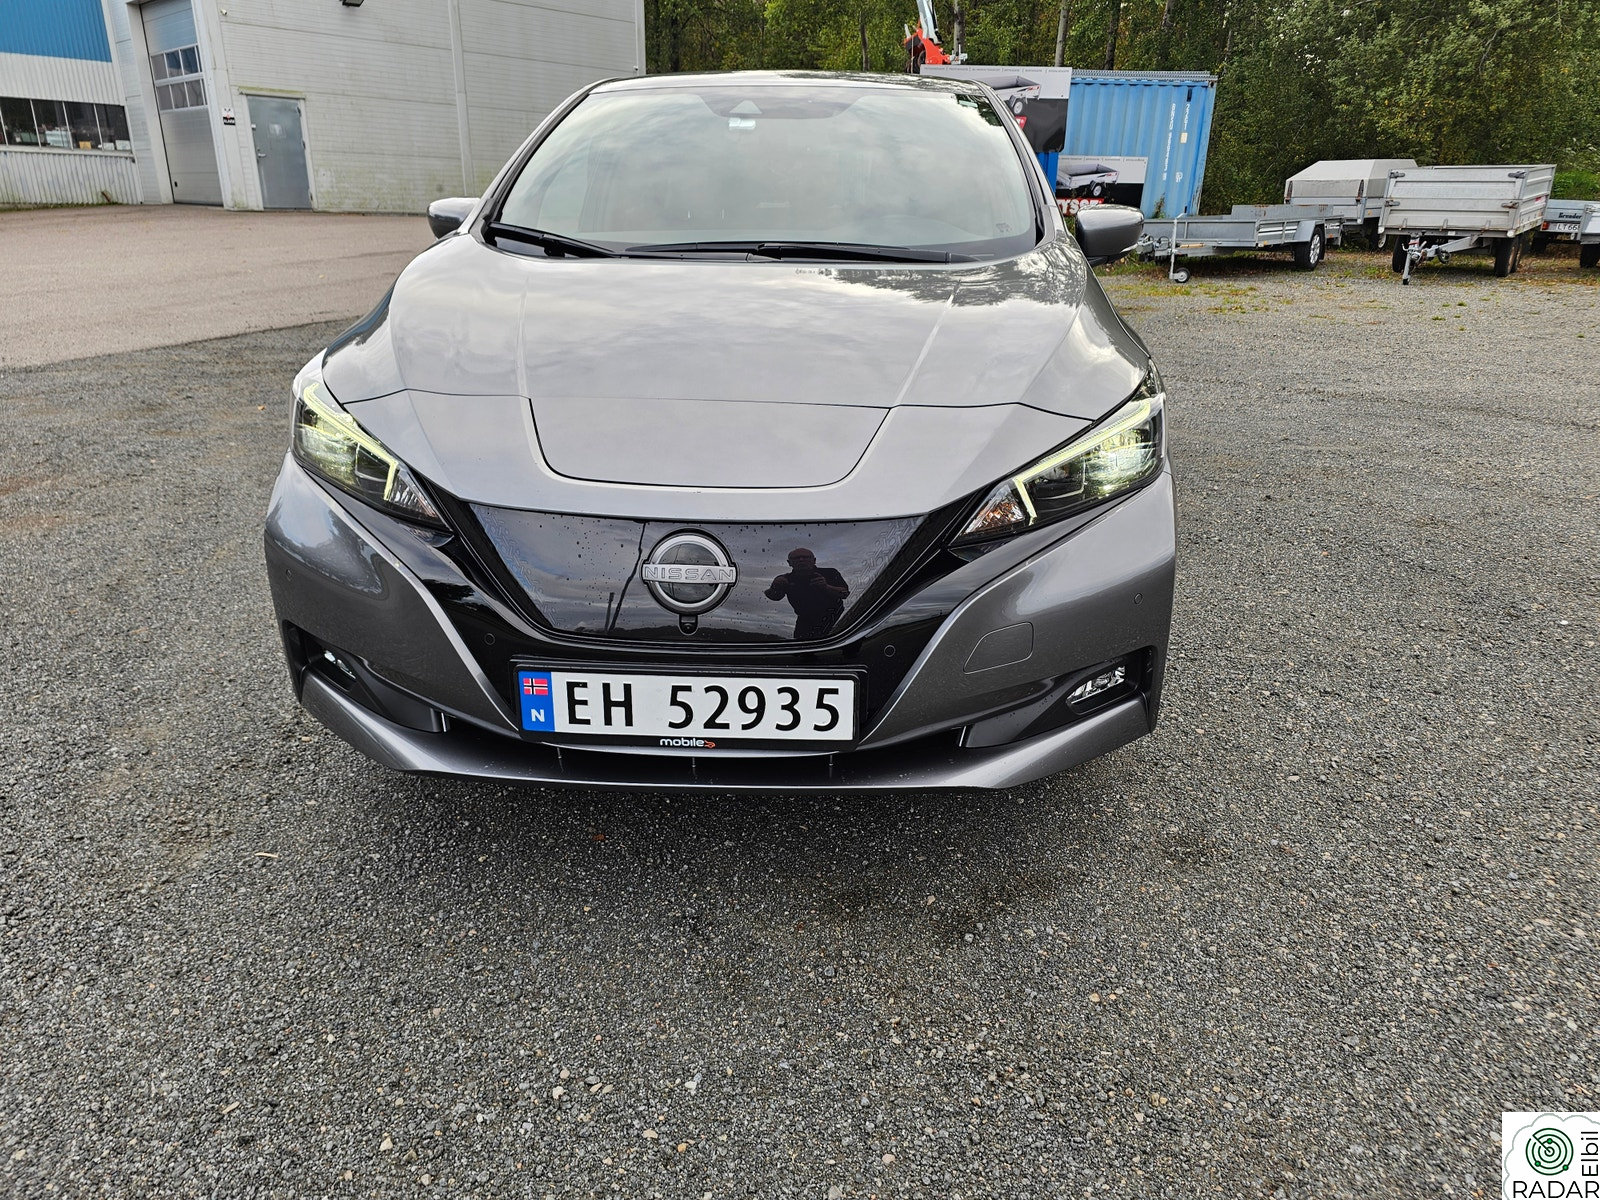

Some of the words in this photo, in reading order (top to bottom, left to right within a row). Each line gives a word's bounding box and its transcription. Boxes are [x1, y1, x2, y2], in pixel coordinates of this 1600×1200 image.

[644, 566, 734, 581] NISSAN
[566, 680, 634, 727] EH
[668, 684, 840, 732] 52935
[531, 708, 545, 722] N
[660, 737, 705, 747] mobile
